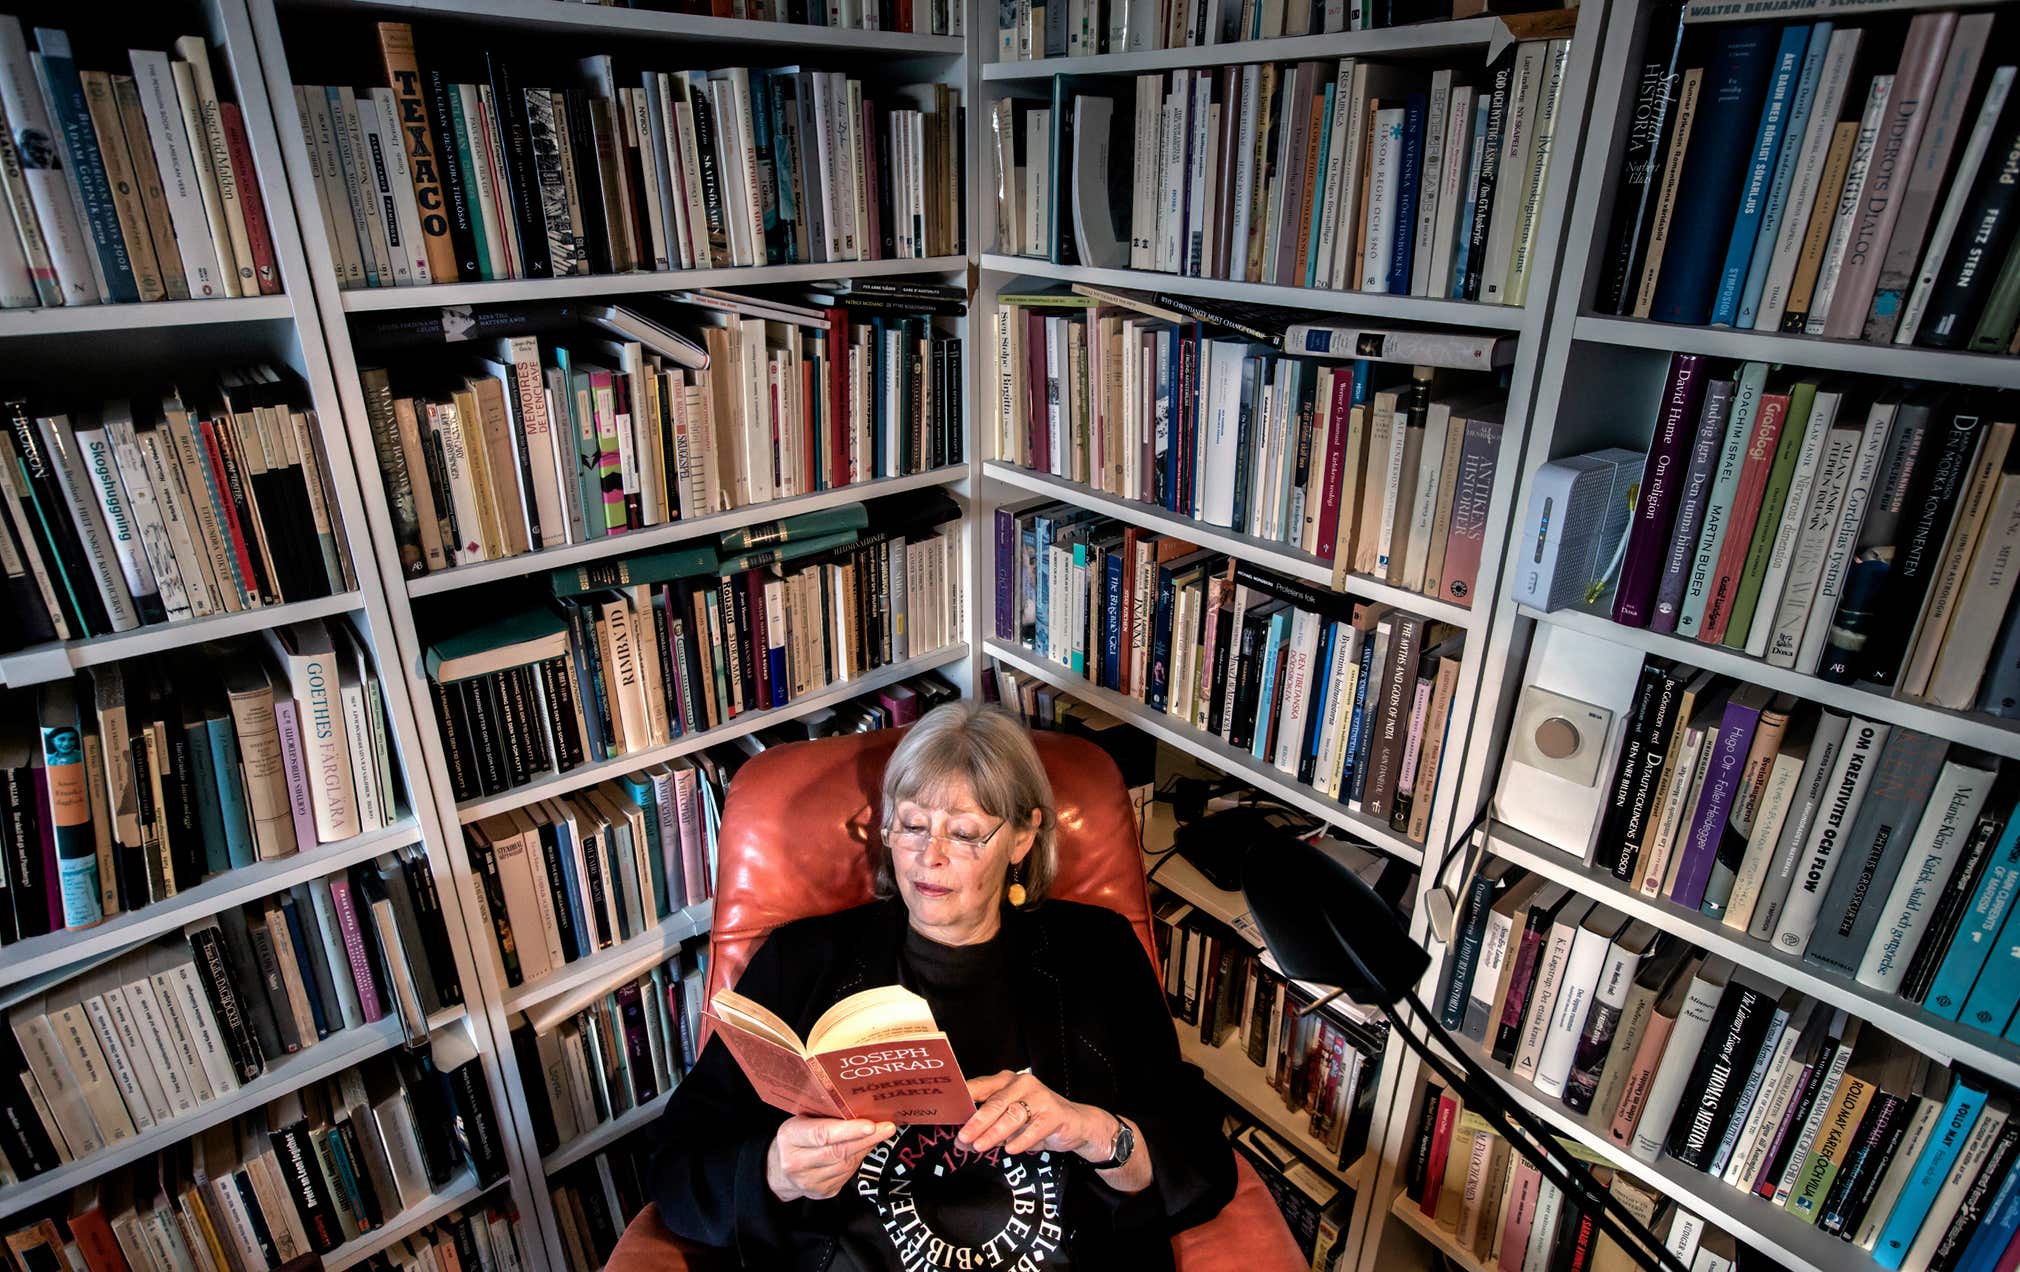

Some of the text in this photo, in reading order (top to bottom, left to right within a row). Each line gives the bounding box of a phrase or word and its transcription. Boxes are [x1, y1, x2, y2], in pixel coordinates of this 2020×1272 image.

[1631, 62, 1661, 154] HISTORIA
[202, 99, 236, 201] Slaget vid Maldon
[393, 70, 448, 237] TEXACO
[1379, 122, 1390, 166] LIKSOM
[1404, 140, 1415, 187] SVENSKA
[1375, 171, 1385, 202] REGN
[1853, 98, 1918, 267] DIDEROTS DIALOG
[1372, 207, 1381, 232] OCH
[1957, 208, 1999, 288] FRITZ STERN
[1001, 311, 1013, 414] Sven Stolpe Birgitta
[518, 361, 540, 435] MEMOIRES
[1703, 392, 1725, 438] Ludvig
[1643, 368, 1691, 521] David Hume Om religion
[1751, 401, 1781, 462] Grafologi
[1809, 411, 1824, 441] ALLAN
[677, 434, 691, 481] SKUGGSPEL
[1696, 437, 1713, 464] Igra
[1802, 442, 1816, 468] JANIK
[91, 439, 135, 542] Skogshuggning
[1456, 453, 1479, 536] HISTORIER
[1470, 455, 1493, 540] ANTIKENS
[1688, 470, 1705, 498] Den
[1690, 384, 1754, 597] JOACHIM ISRAEL MARTIN BUBER
[1787, 473, 1807, 522] Närvarons
[1679, 497, 1698, 533] tunna
[1822, 418, 1885, 598] ALLAN JANIK Cordelias tystnad
[1773, 523, 1794, 570] dimension
[723, 582, 734, 624] Rouaud
[1133, 598, 1143, 648] INANNA
[1291, 653, 1306, 720] DEN TIBETANSKA
[1384, 622, 1413, 740] THE MYTHS AND GODS OF INDIA
[310, 662, 350, 828] GOETHES FÄRGLÄRA
[1616, 740, 1640, 807] DEN INRE BILDEN
[1698, 725, 1743, 851] Hugo Ott Fallet Heidegger
[660, 778, 674, 829] Yourcenar
[678, 774, 691, 825] Yourcenar
[1806, 725, 1875, 893] OM KREATIVITET OCH FLOW
[1946, 783, 1972, 827] Melanie
[1933, 823, 1954, 852] Klein
[1844, 831, 1888, 932] PHYLLIS GROSSKURTH
[1905, 884, 1927, 913] skuld
[1979, 864, 2004, 914] OF MARXISM
[1985, 869, 2018, 931] MAIN CURRENTS
[1556, 937, 1565, 946] K.
[1897, 908, 1916, 931] och
[1553, 946, 1563, 954] E.
[1534, 1004, 1547, 1025] etiska
[1540, 990, 1551, 1004] Det
[1742, 990, 1756, 1006] The
[1528, 1025, 1541, 1048] kravet
[1767, 1017, 1782, 1043] Thomas
[839, 1058, 945, 1081] CONRAD
[840, 1047, 929, 1070] JOSEPH
[1757, 1041, 1772, 1067] Merton
[851, 1074, 952, 1096] MÖRKRETS
[872, 1086, 944, 1102] HJÄRTA
[1705, 1062, 1730, 1109] THOMAS
[1845, 1079, 1863, 1110] ROLLO
[1689, 1107, 1714, 1151] MERTON
[1836, 1108, 1850, 1129] MAY
[1867, 1097, 1896, 1147] ROLLO MAY
[1943, 1102, 1970, 1147] ROLLO MAY
